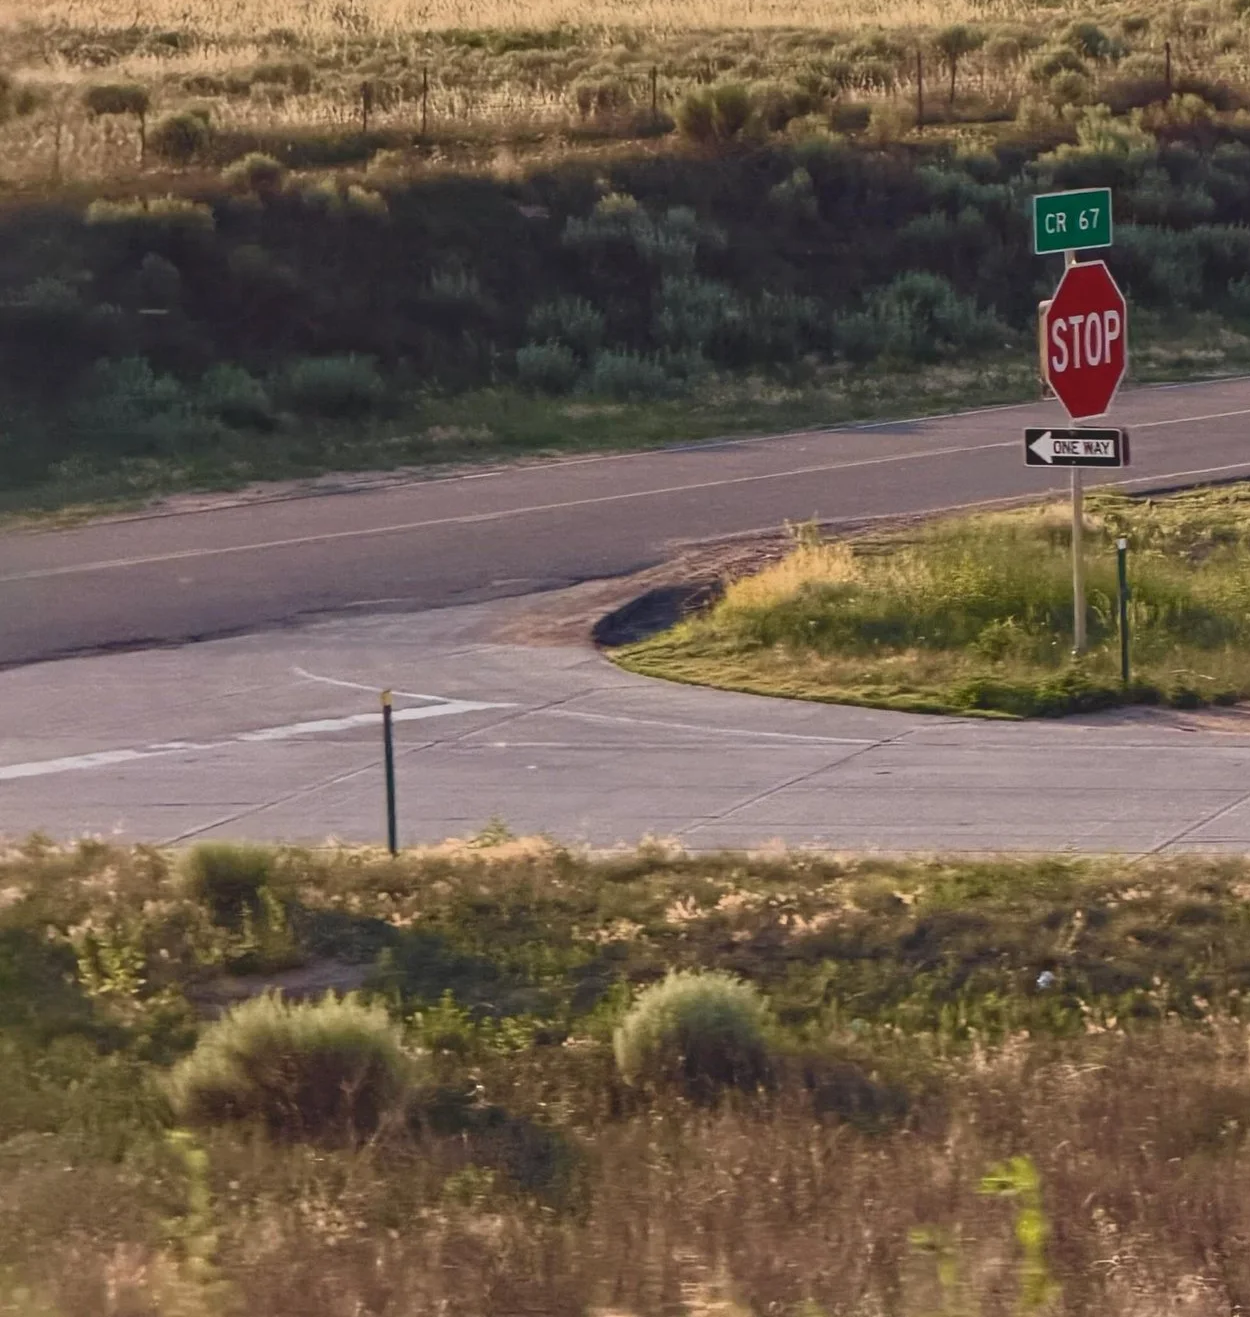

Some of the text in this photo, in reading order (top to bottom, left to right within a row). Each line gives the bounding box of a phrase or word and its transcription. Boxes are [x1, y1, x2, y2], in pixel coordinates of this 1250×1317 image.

[1044, 208, 1100, 234] CR 67
[1051, 310, 1121, 373] STOP
[1053, 440, 1110, 455] ONE WAY
